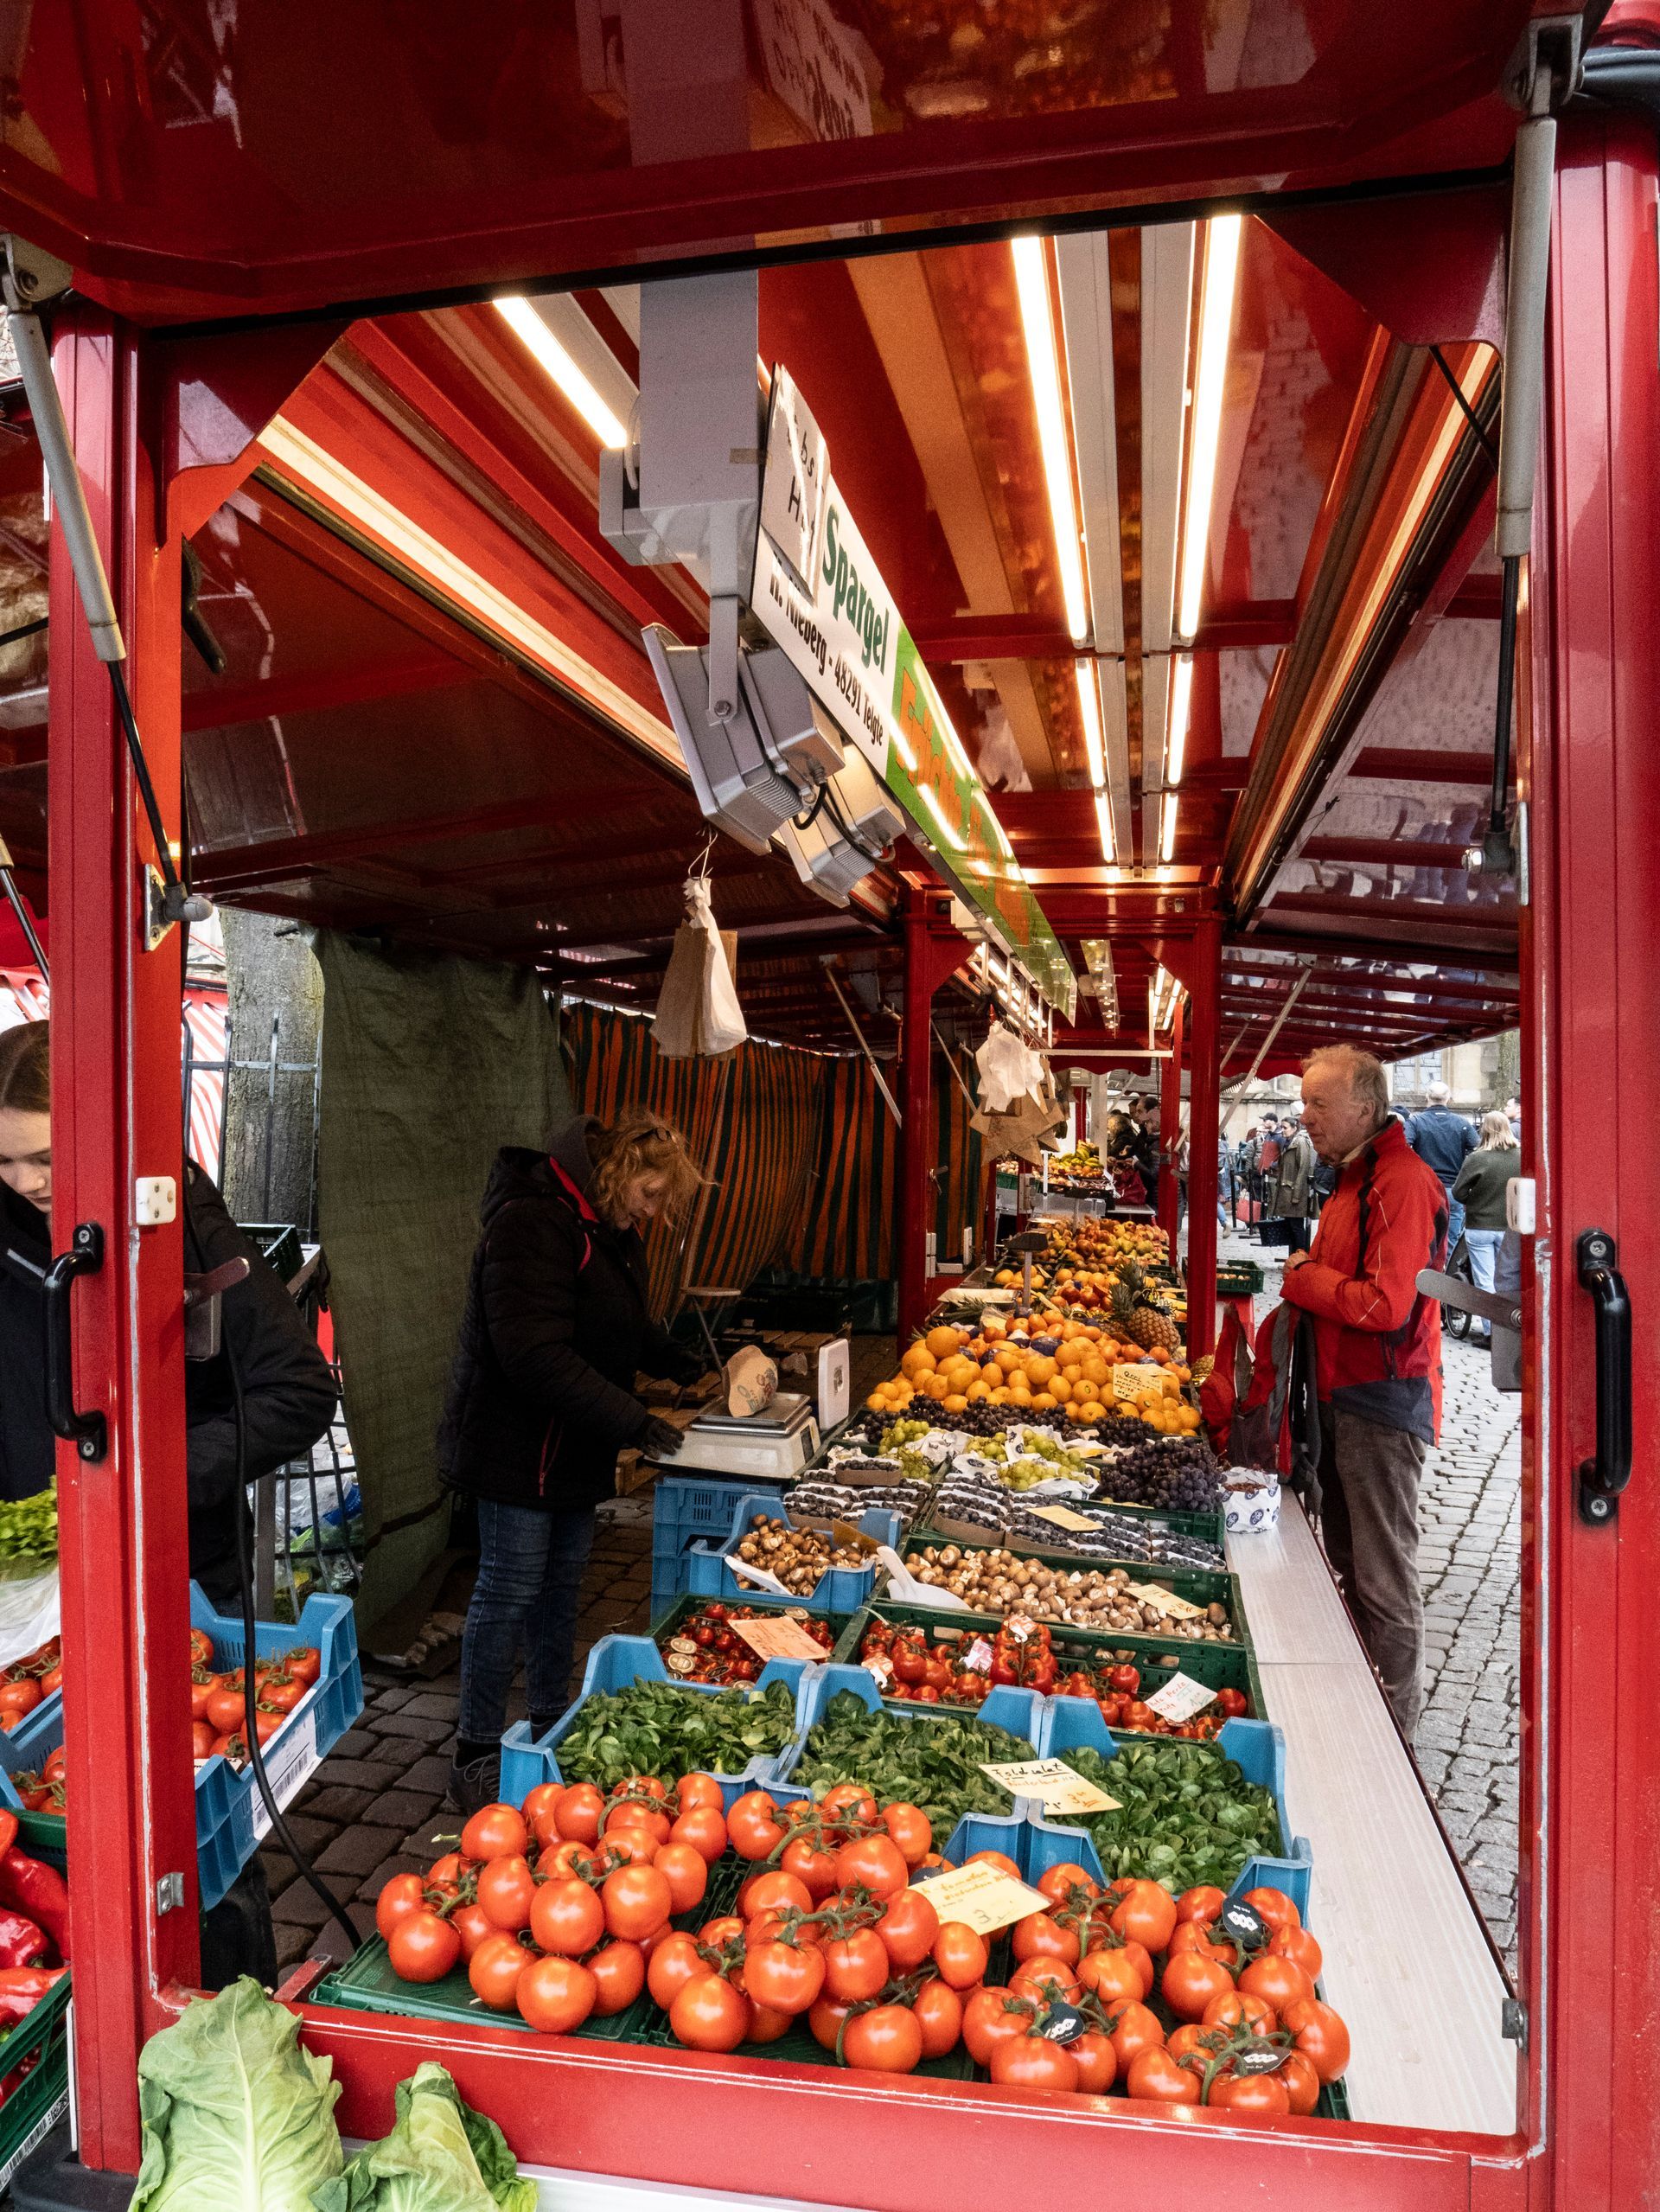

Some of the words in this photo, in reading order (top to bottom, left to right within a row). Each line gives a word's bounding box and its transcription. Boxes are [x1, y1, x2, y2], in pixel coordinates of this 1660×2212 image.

[822, 502, 890, 677] Spargel
[833, 650, 862, 718] 48291
[863, 695, 884, 747] Telgte
